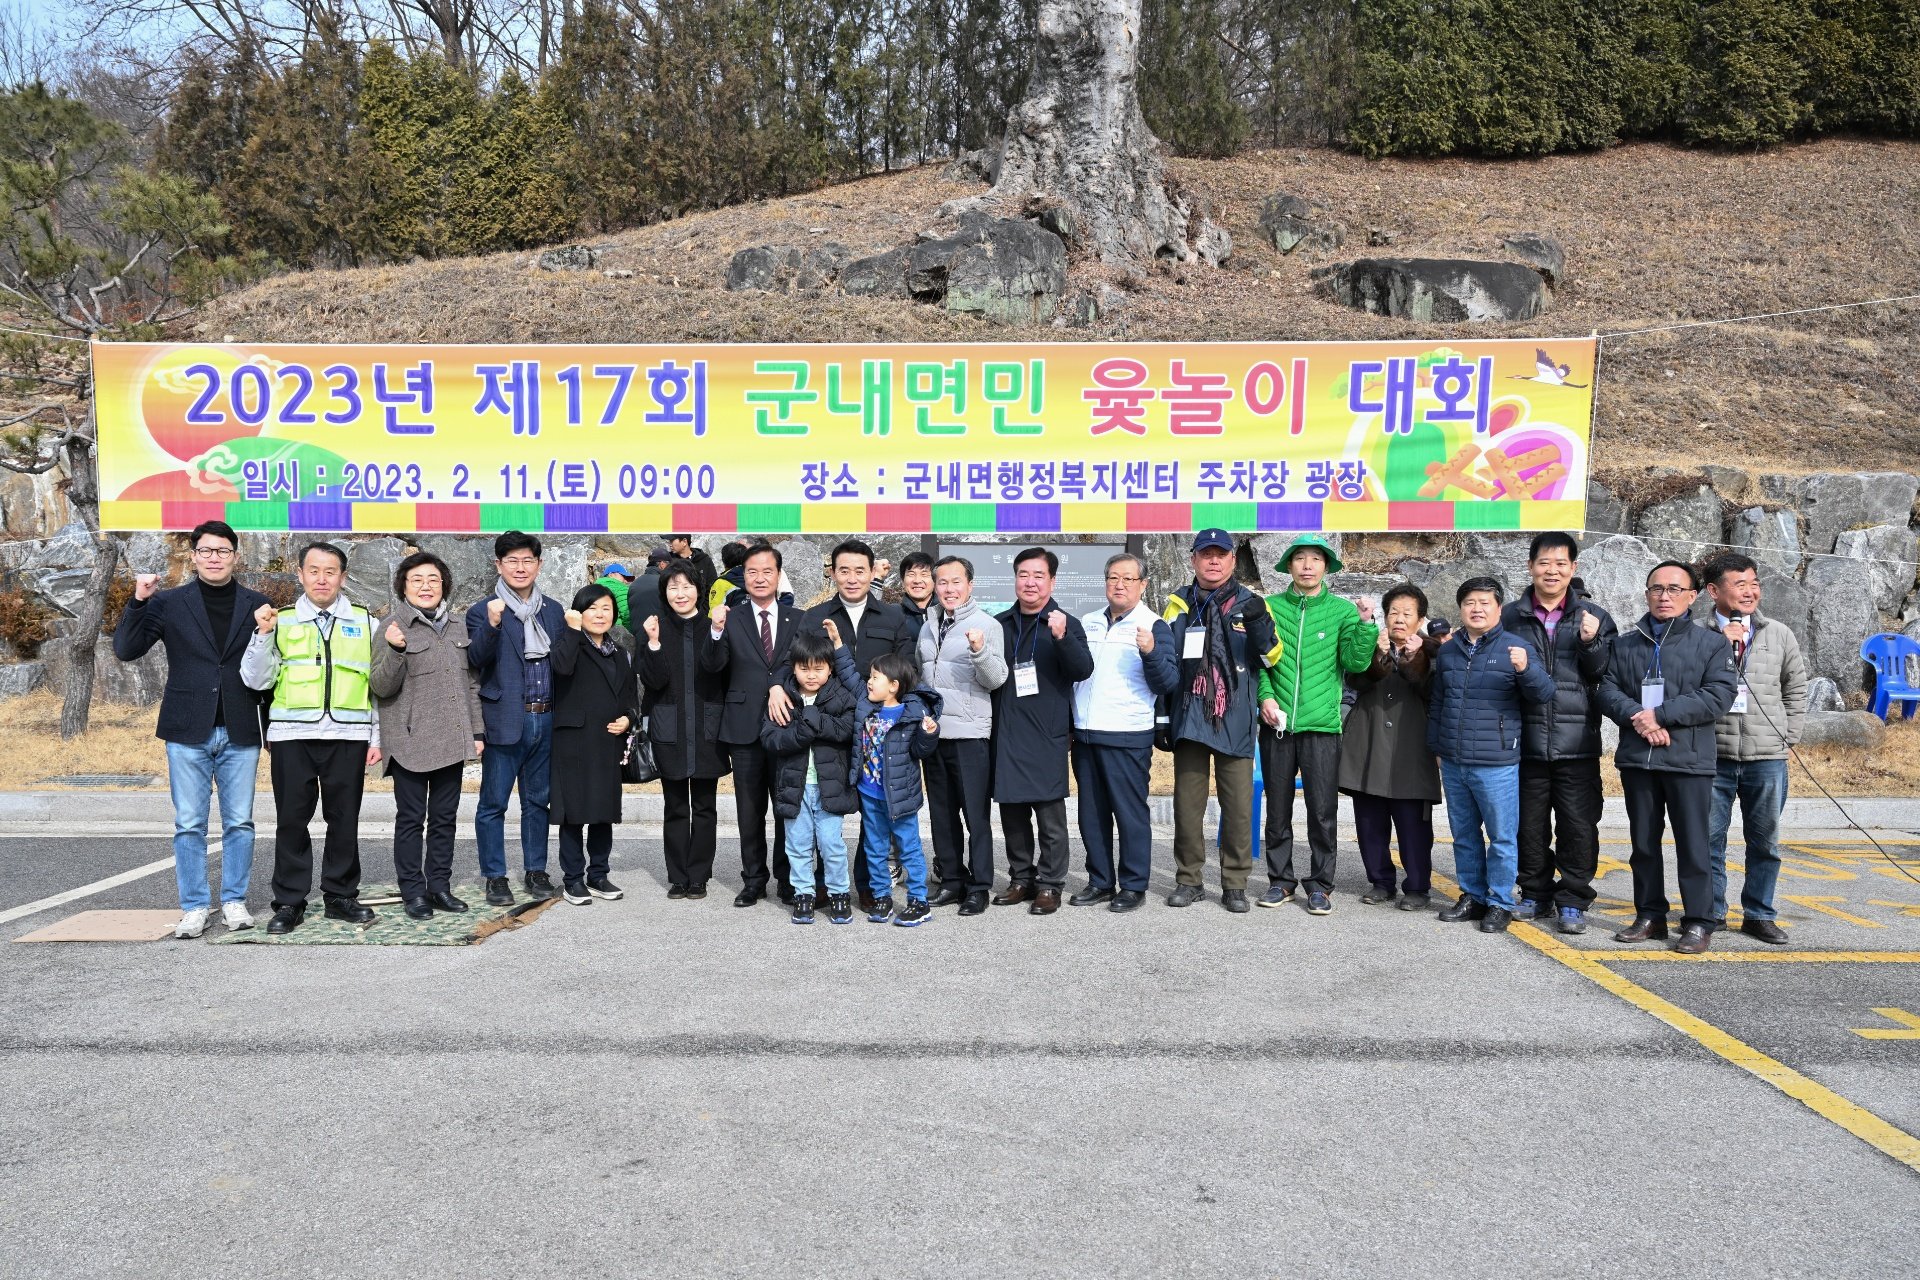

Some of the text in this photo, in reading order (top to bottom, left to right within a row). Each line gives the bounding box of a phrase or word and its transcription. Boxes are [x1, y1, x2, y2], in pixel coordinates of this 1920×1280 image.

[185, 356, 1493, 437] 2023년 제17회 군내면민 윷놀이 대회
[243, 460, 299, 499] 일시
[343, 464, 434, 498] 2023.
[453, 464, 481, 498] 2.
[501, 461, 601, 501] 11.(토)
[619, 464, 716, 499] 09:00
[801, 462, 859, 501] 장소
[903, 461, 1179, 501] 군내면행정복지센터
[1197, 461, 1291, 500] 주차장
[1305, 460, 1367, 499] 광장
